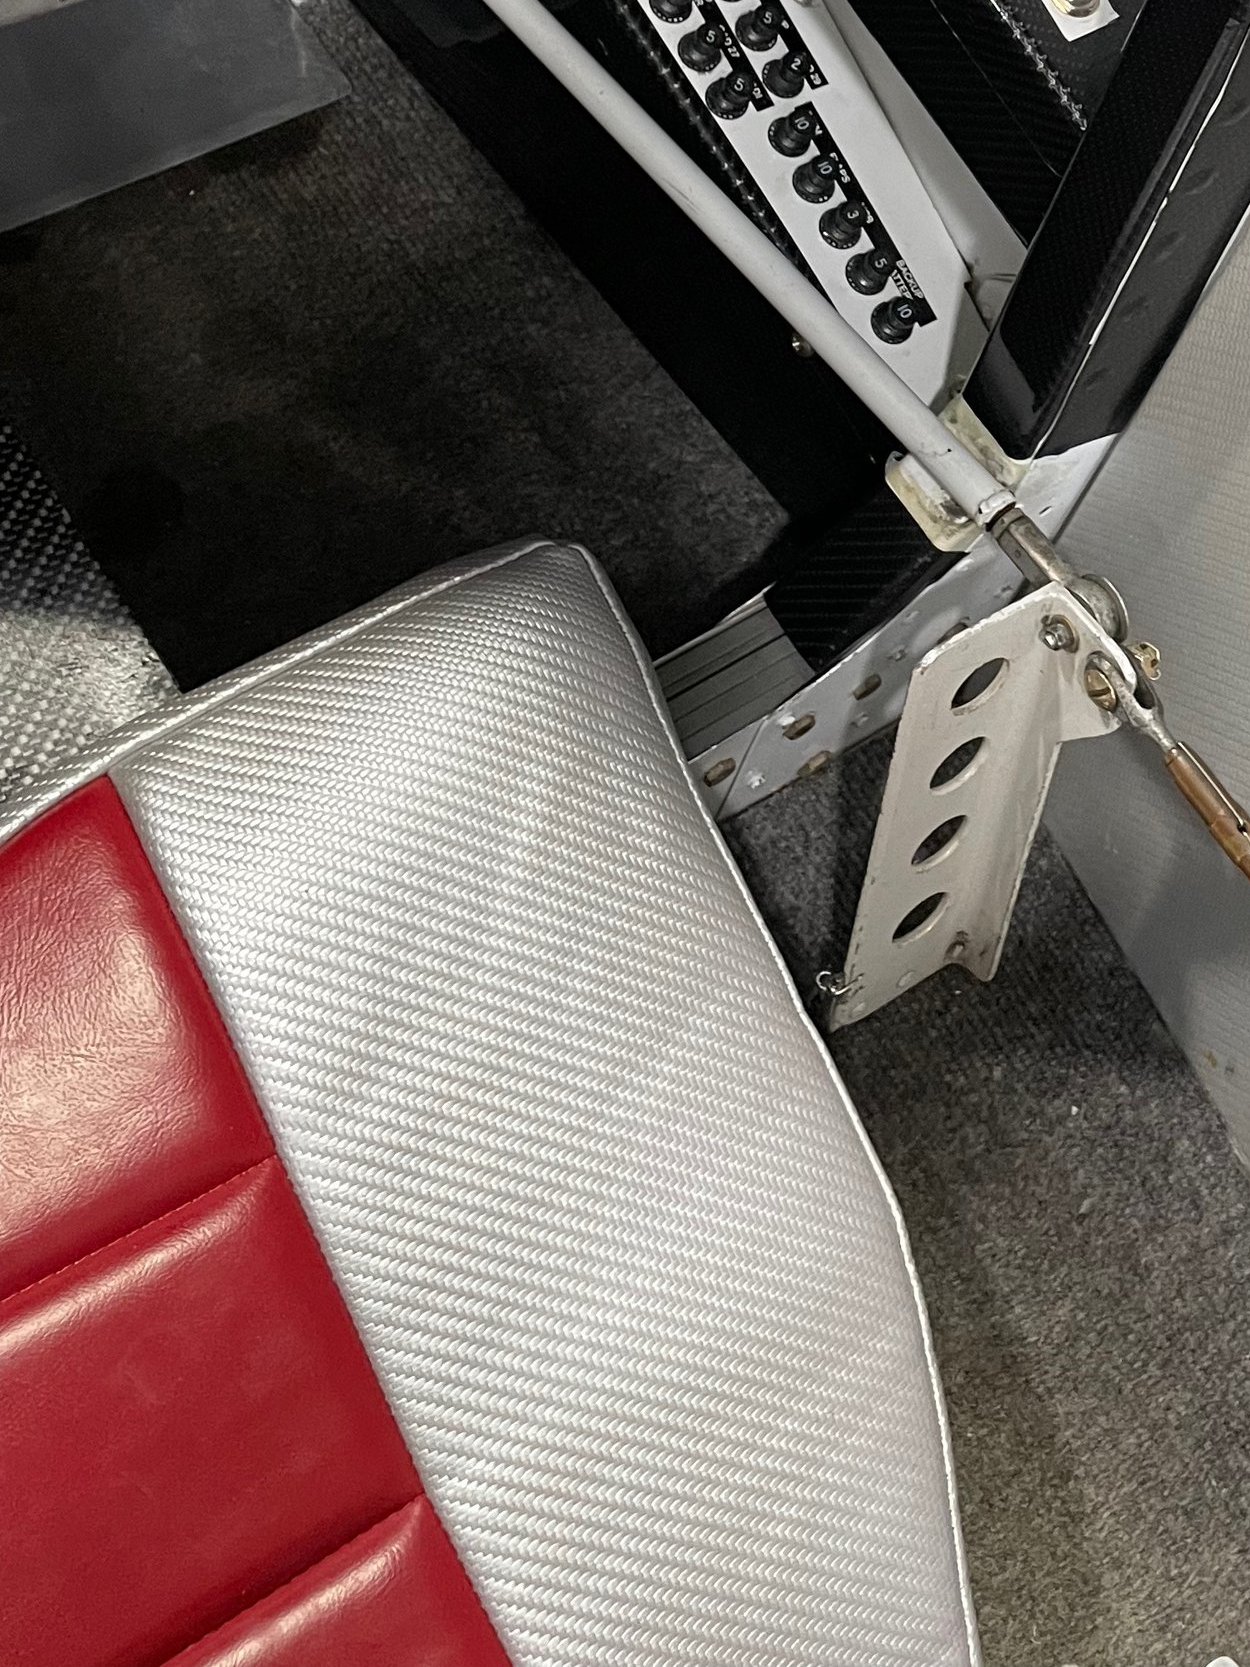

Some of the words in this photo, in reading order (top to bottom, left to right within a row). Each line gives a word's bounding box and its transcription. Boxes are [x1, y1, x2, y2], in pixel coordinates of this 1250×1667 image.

[763, 11, 773, 24] 5
[706, 30, 716, 43] 5
[791, 58, 801, 71] 2
[734, 78, 744, 91] 5
[794, 116, 809, 130] 10
[817, 161, 833, 174] 10
[847, 210, 859, 219] 3
[875, 258, 888, 268] 5
[895, 259, 924, 299] BACKUP
[897, 304, 912, 319] 10
